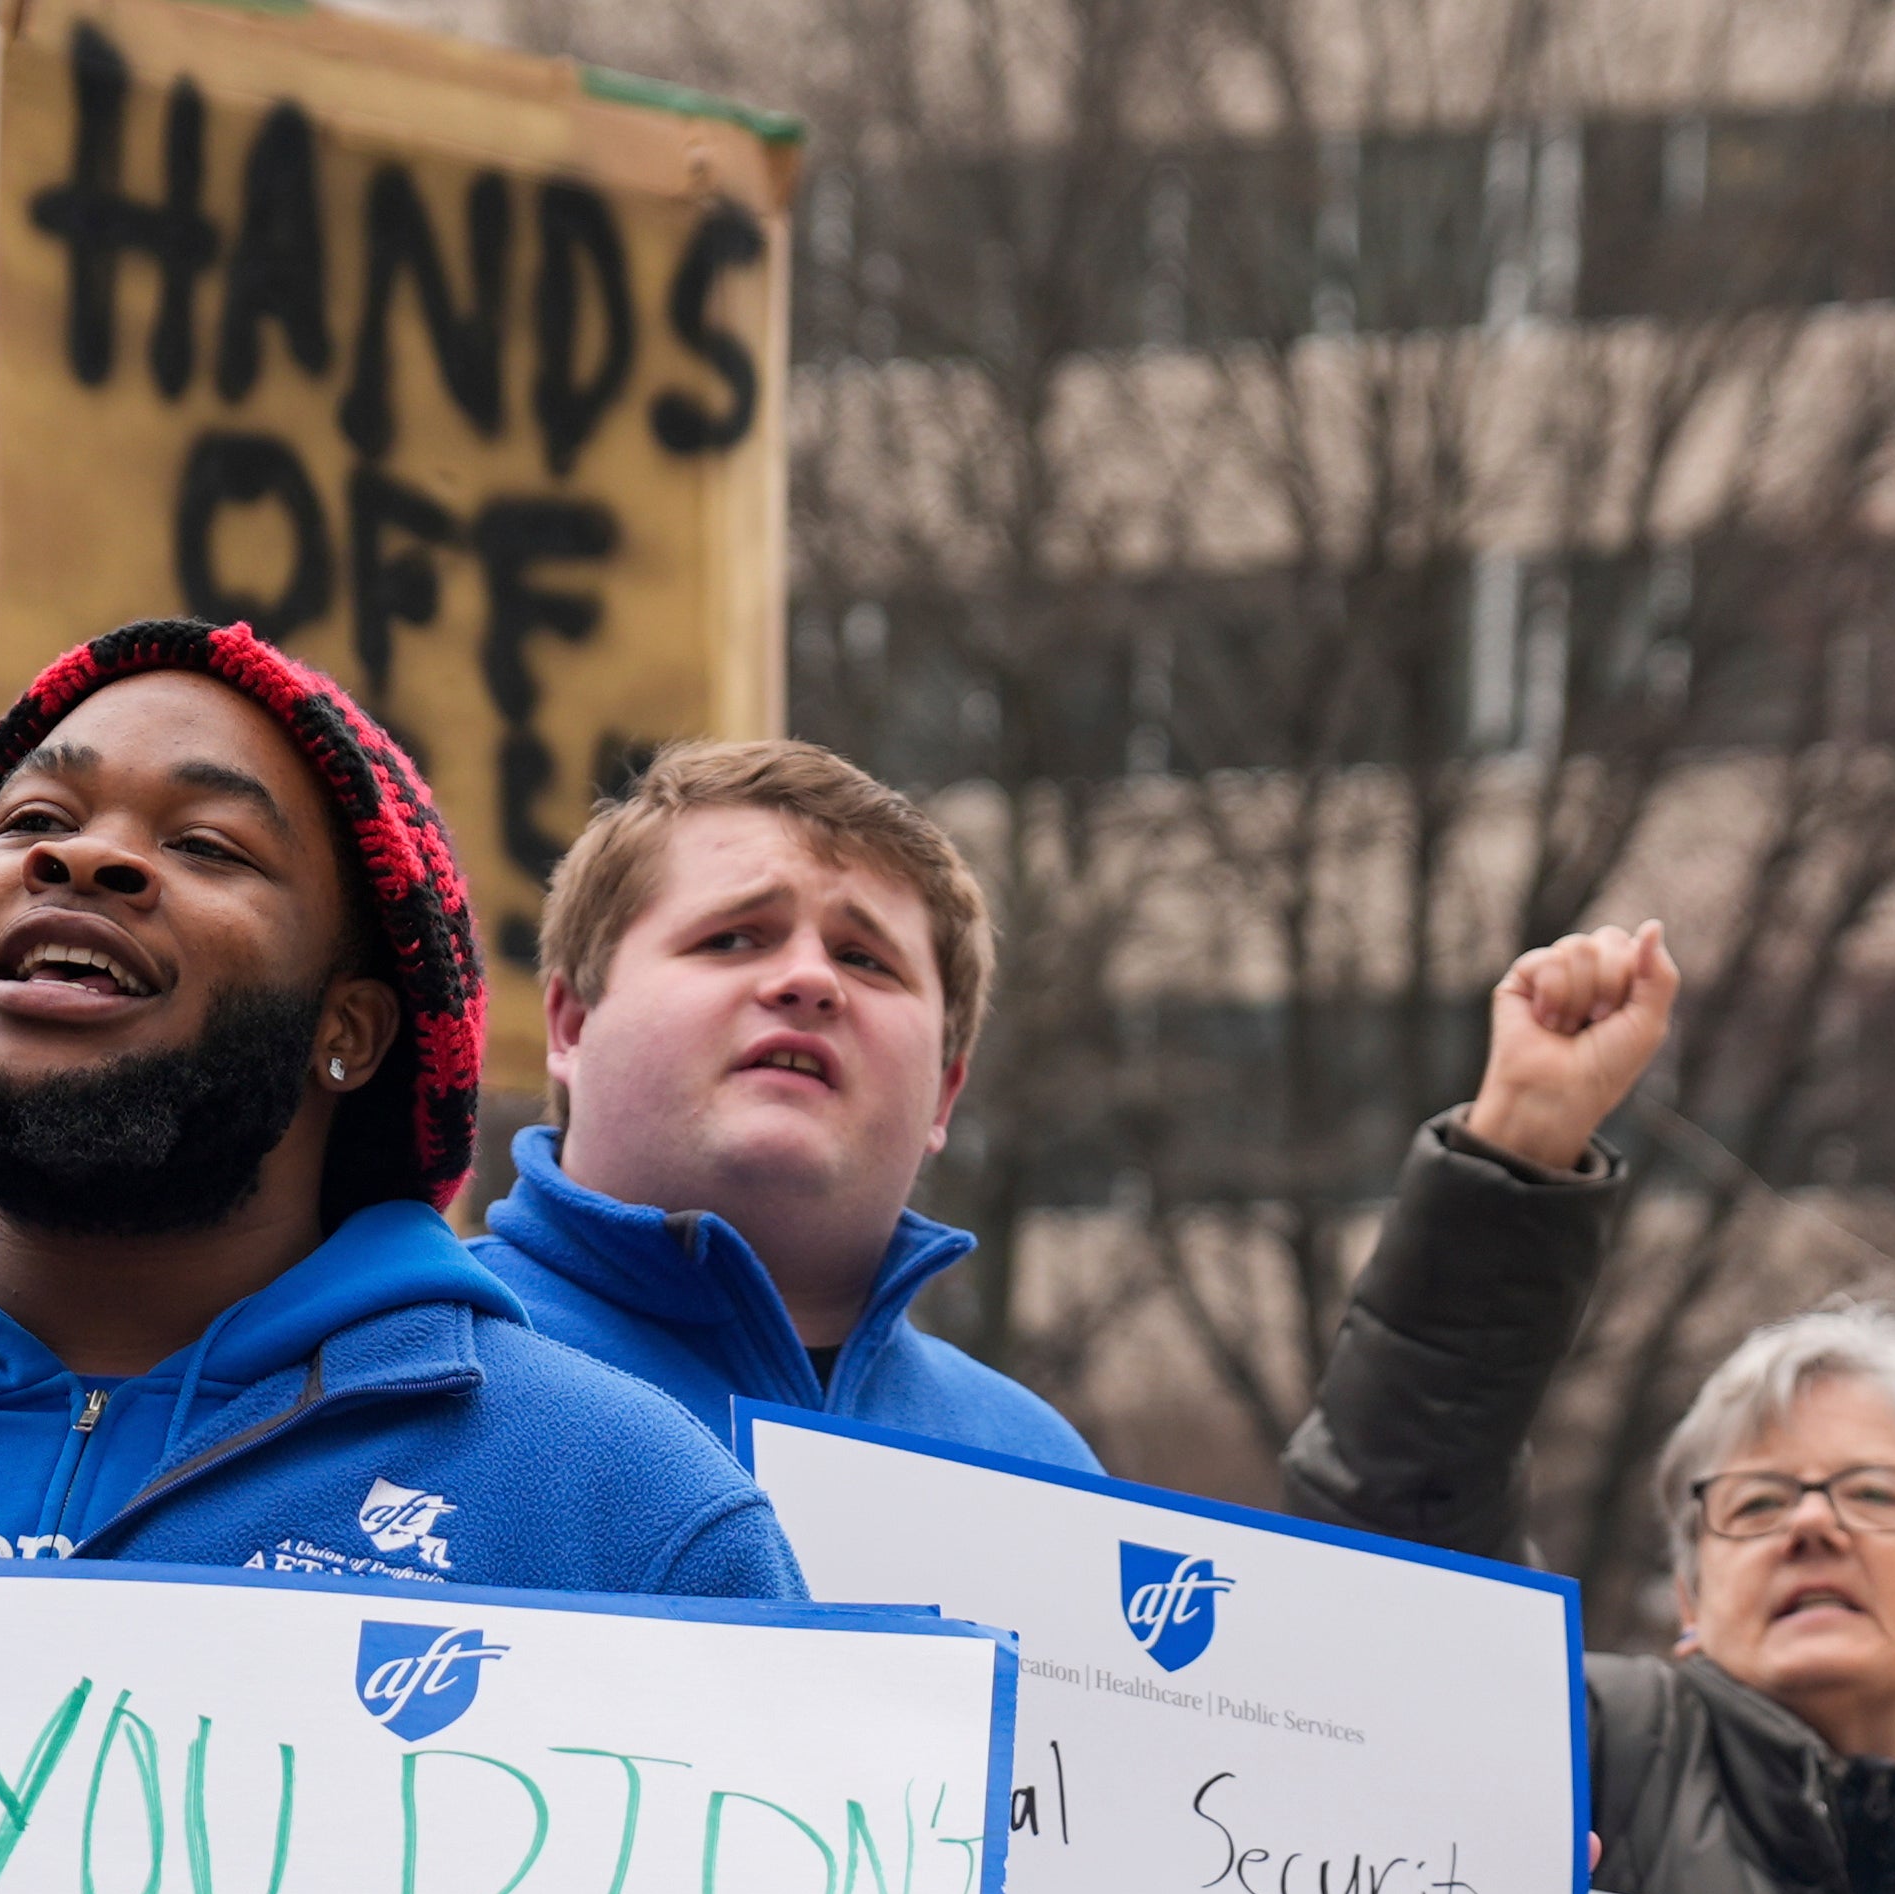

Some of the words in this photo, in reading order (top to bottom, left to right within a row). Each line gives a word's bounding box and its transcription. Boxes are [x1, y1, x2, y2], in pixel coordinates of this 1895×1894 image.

[31, 25, 768, 478] HANDS
[176, 430, 621, 728] OFF
[295, 1540, 346, 1563] Union
[349, 1557, 370, 1572] of
[362, 1493, 456, 1534] aft
[1127, 1554, 1236, 1652] aft
[365, 1627, 510, 1724] aft
[1094, 1668, 1203, 1712] Healthcare
[1216, 1695, 1279, 1728] Public
[1283, 1710, 1366, 1746] Services
